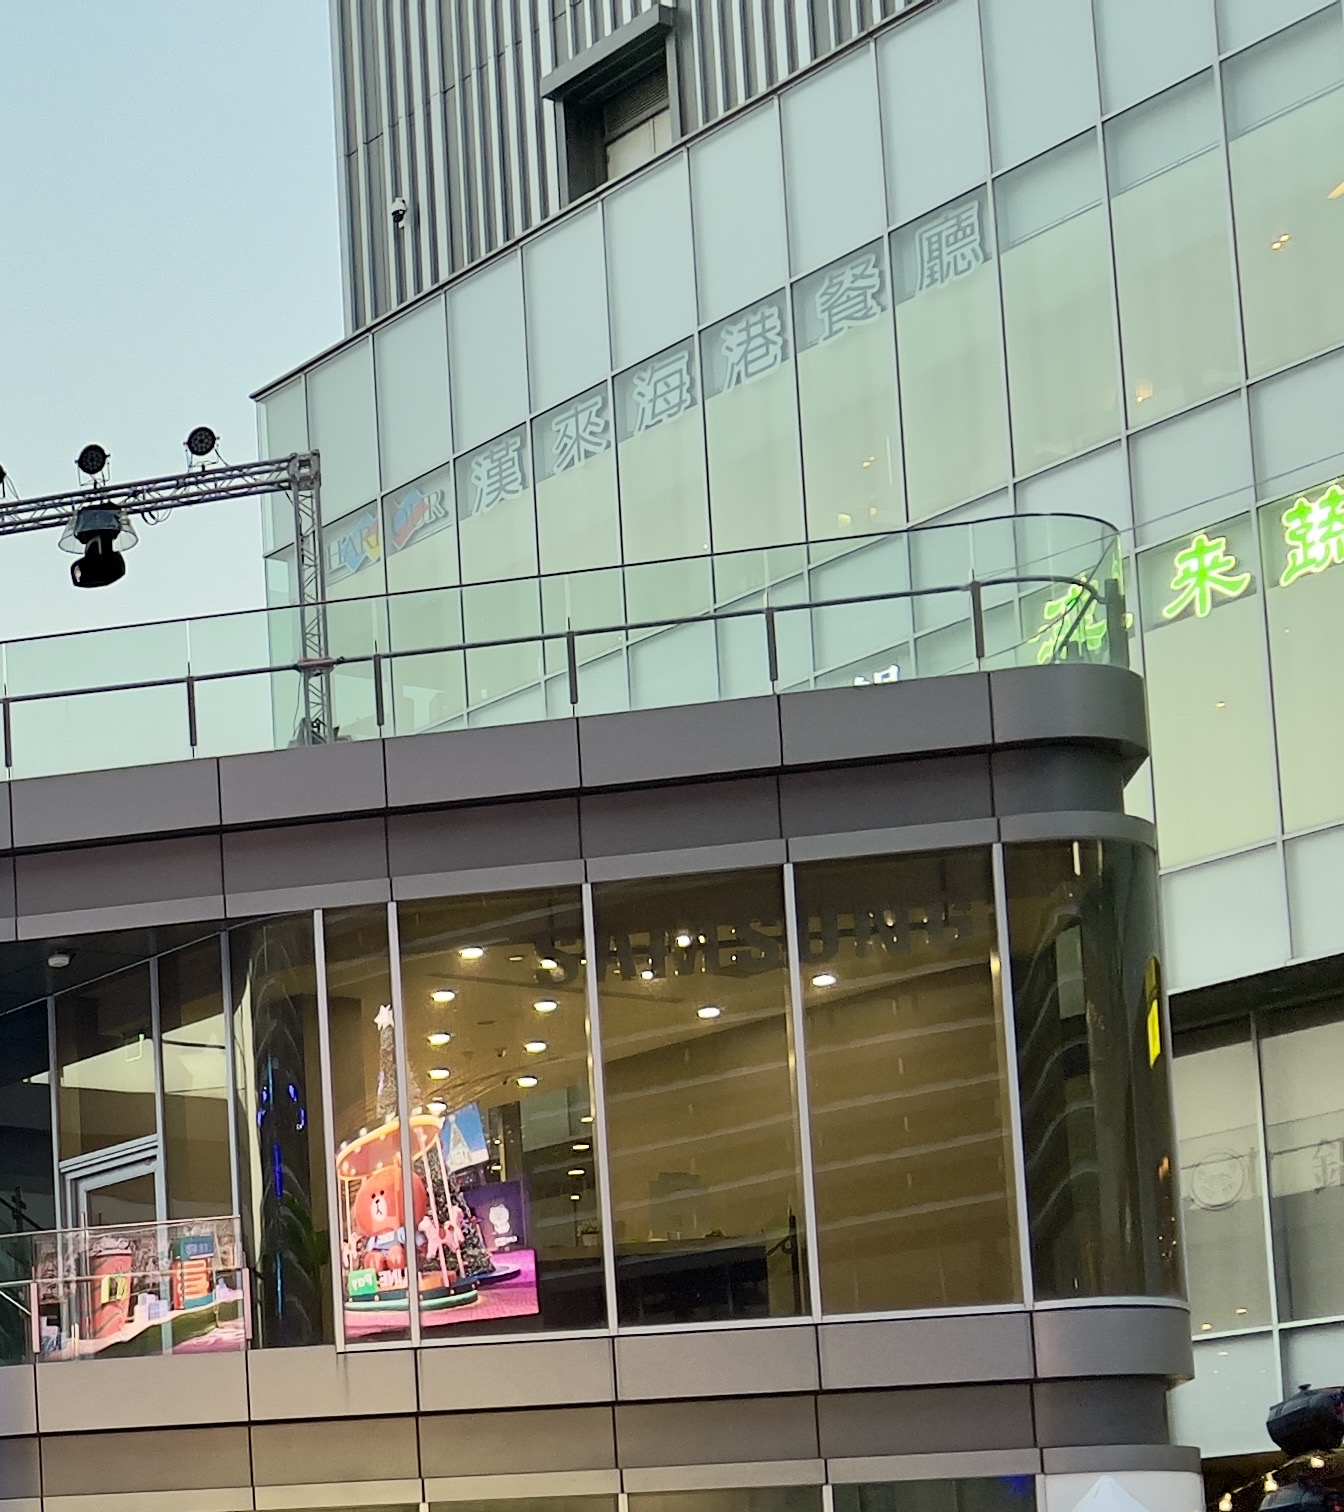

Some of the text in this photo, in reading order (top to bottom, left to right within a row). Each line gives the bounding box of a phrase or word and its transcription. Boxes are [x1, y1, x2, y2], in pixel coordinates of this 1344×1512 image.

[469, 199, 986, 516] 漢來海港餐廳
